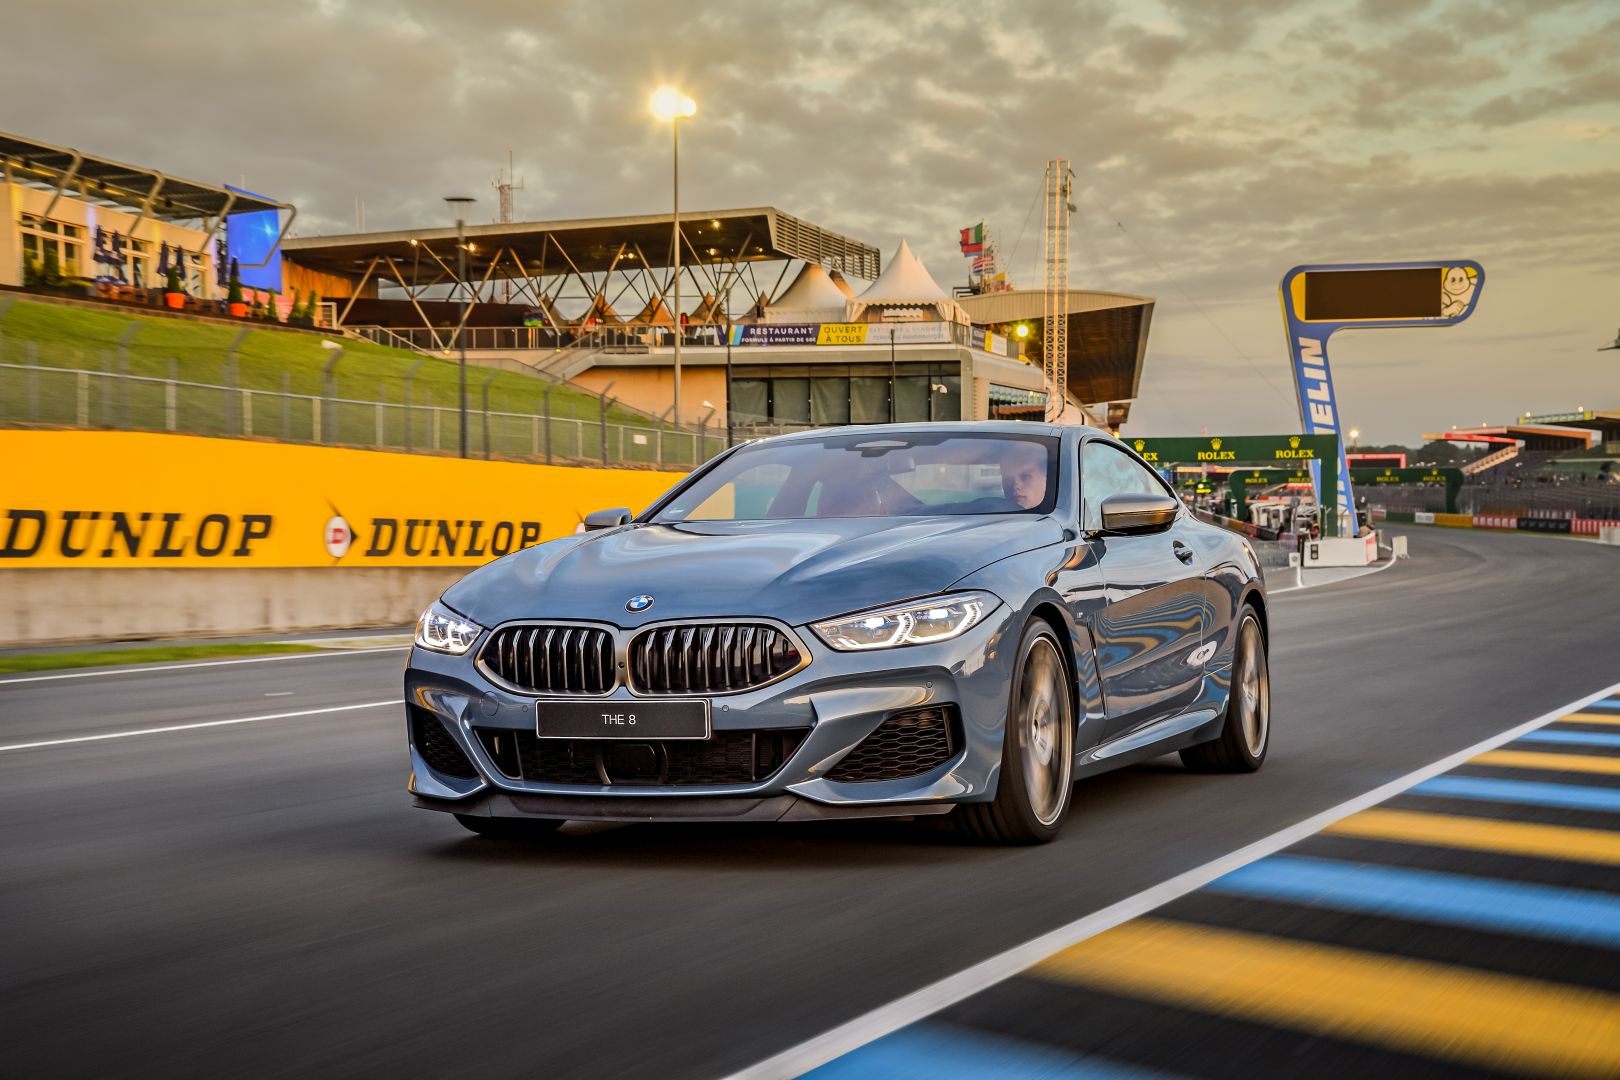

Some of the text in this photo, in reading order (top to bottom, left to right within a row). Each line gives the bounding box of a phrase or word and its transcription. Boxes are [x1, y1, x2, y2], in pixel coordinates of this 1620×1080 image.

[750, 327, 814, 335] RESTAURANT
[824, 326, 863, 334] OUVERT
[836, 335, 862, 343] TOUS
[1197, 451, 1235, 460] ROLEX
[1275, 449, 1314, 458] ROLEX
[0, 508, 274, 559] DUNLOP
[364, 517, 542, 557] DUNLOP
[602, 714, 637, 725] THE 8
